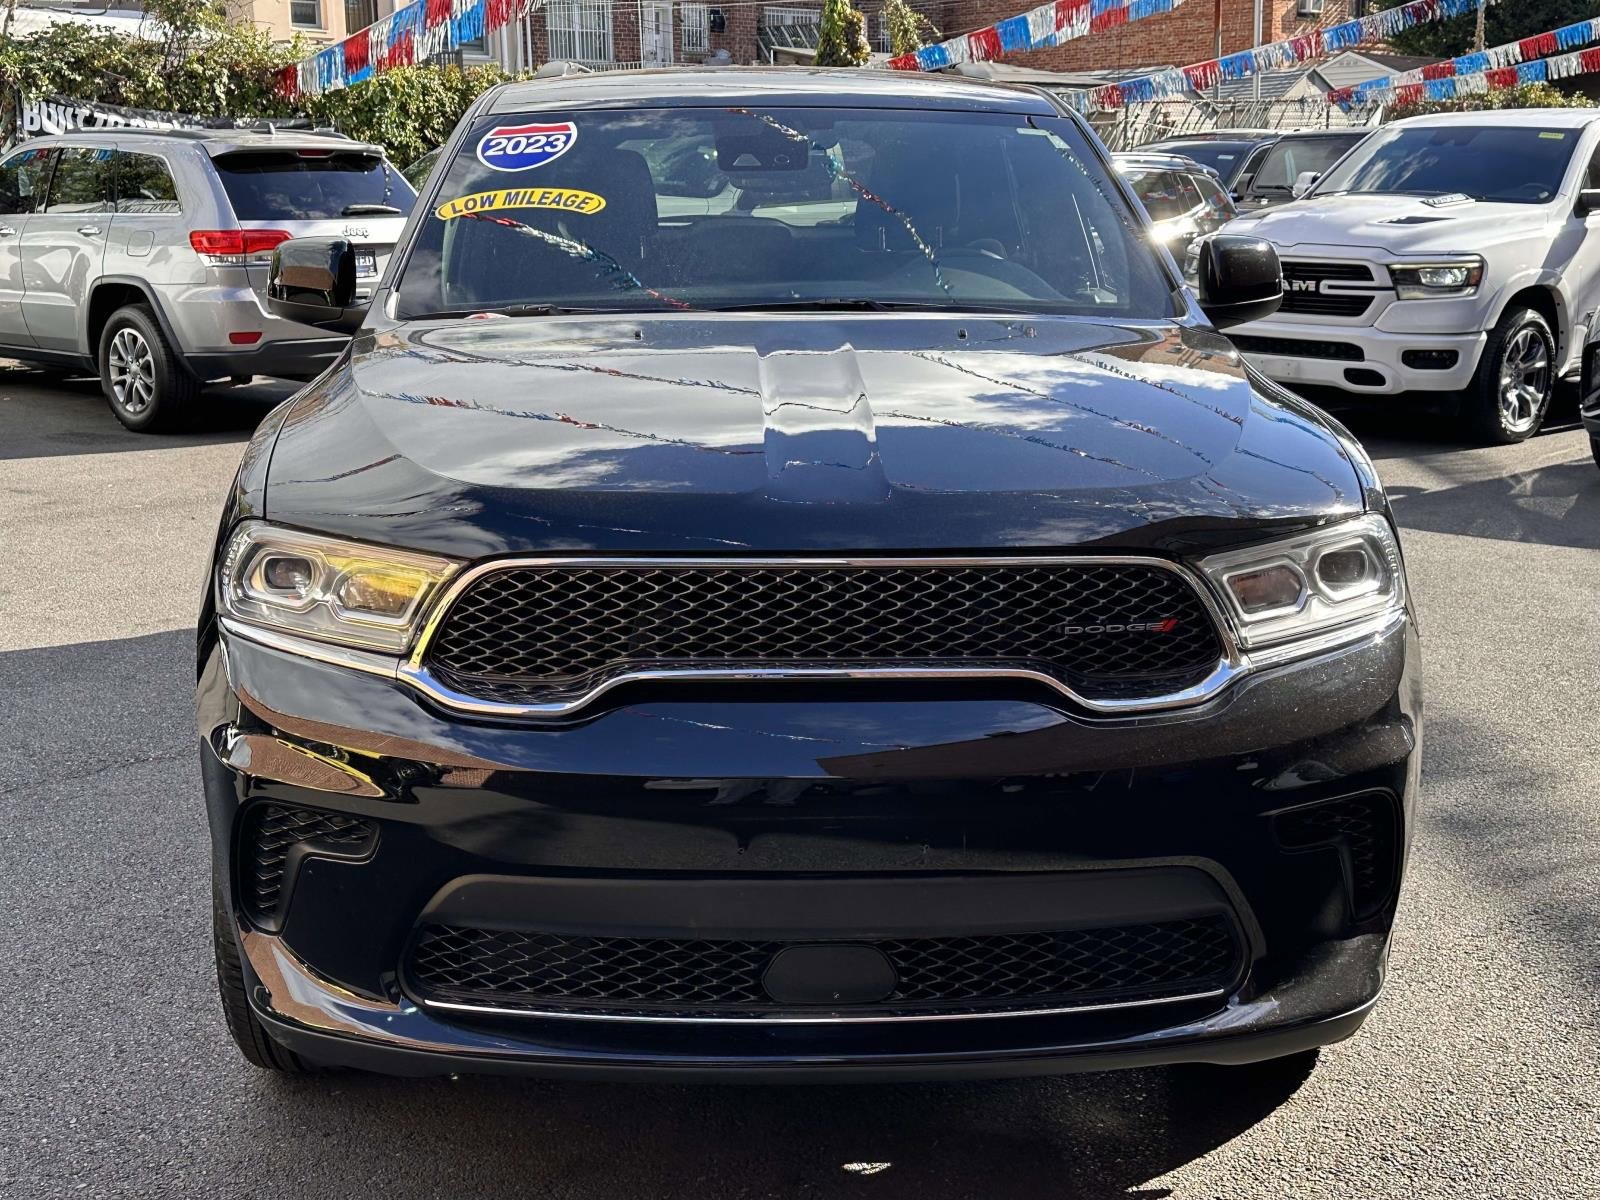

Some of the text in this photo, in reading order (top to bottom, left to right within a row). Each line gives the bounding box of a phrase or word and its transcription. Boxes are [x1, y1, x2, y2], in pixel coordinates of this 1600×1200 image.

[484, 134, 565, 156] 2023
[450, 190, 594, 214] LOW MILEAGE
[1282, 279, 1316, 291] AM
[1064, 621, 1163, 635] DODGE
